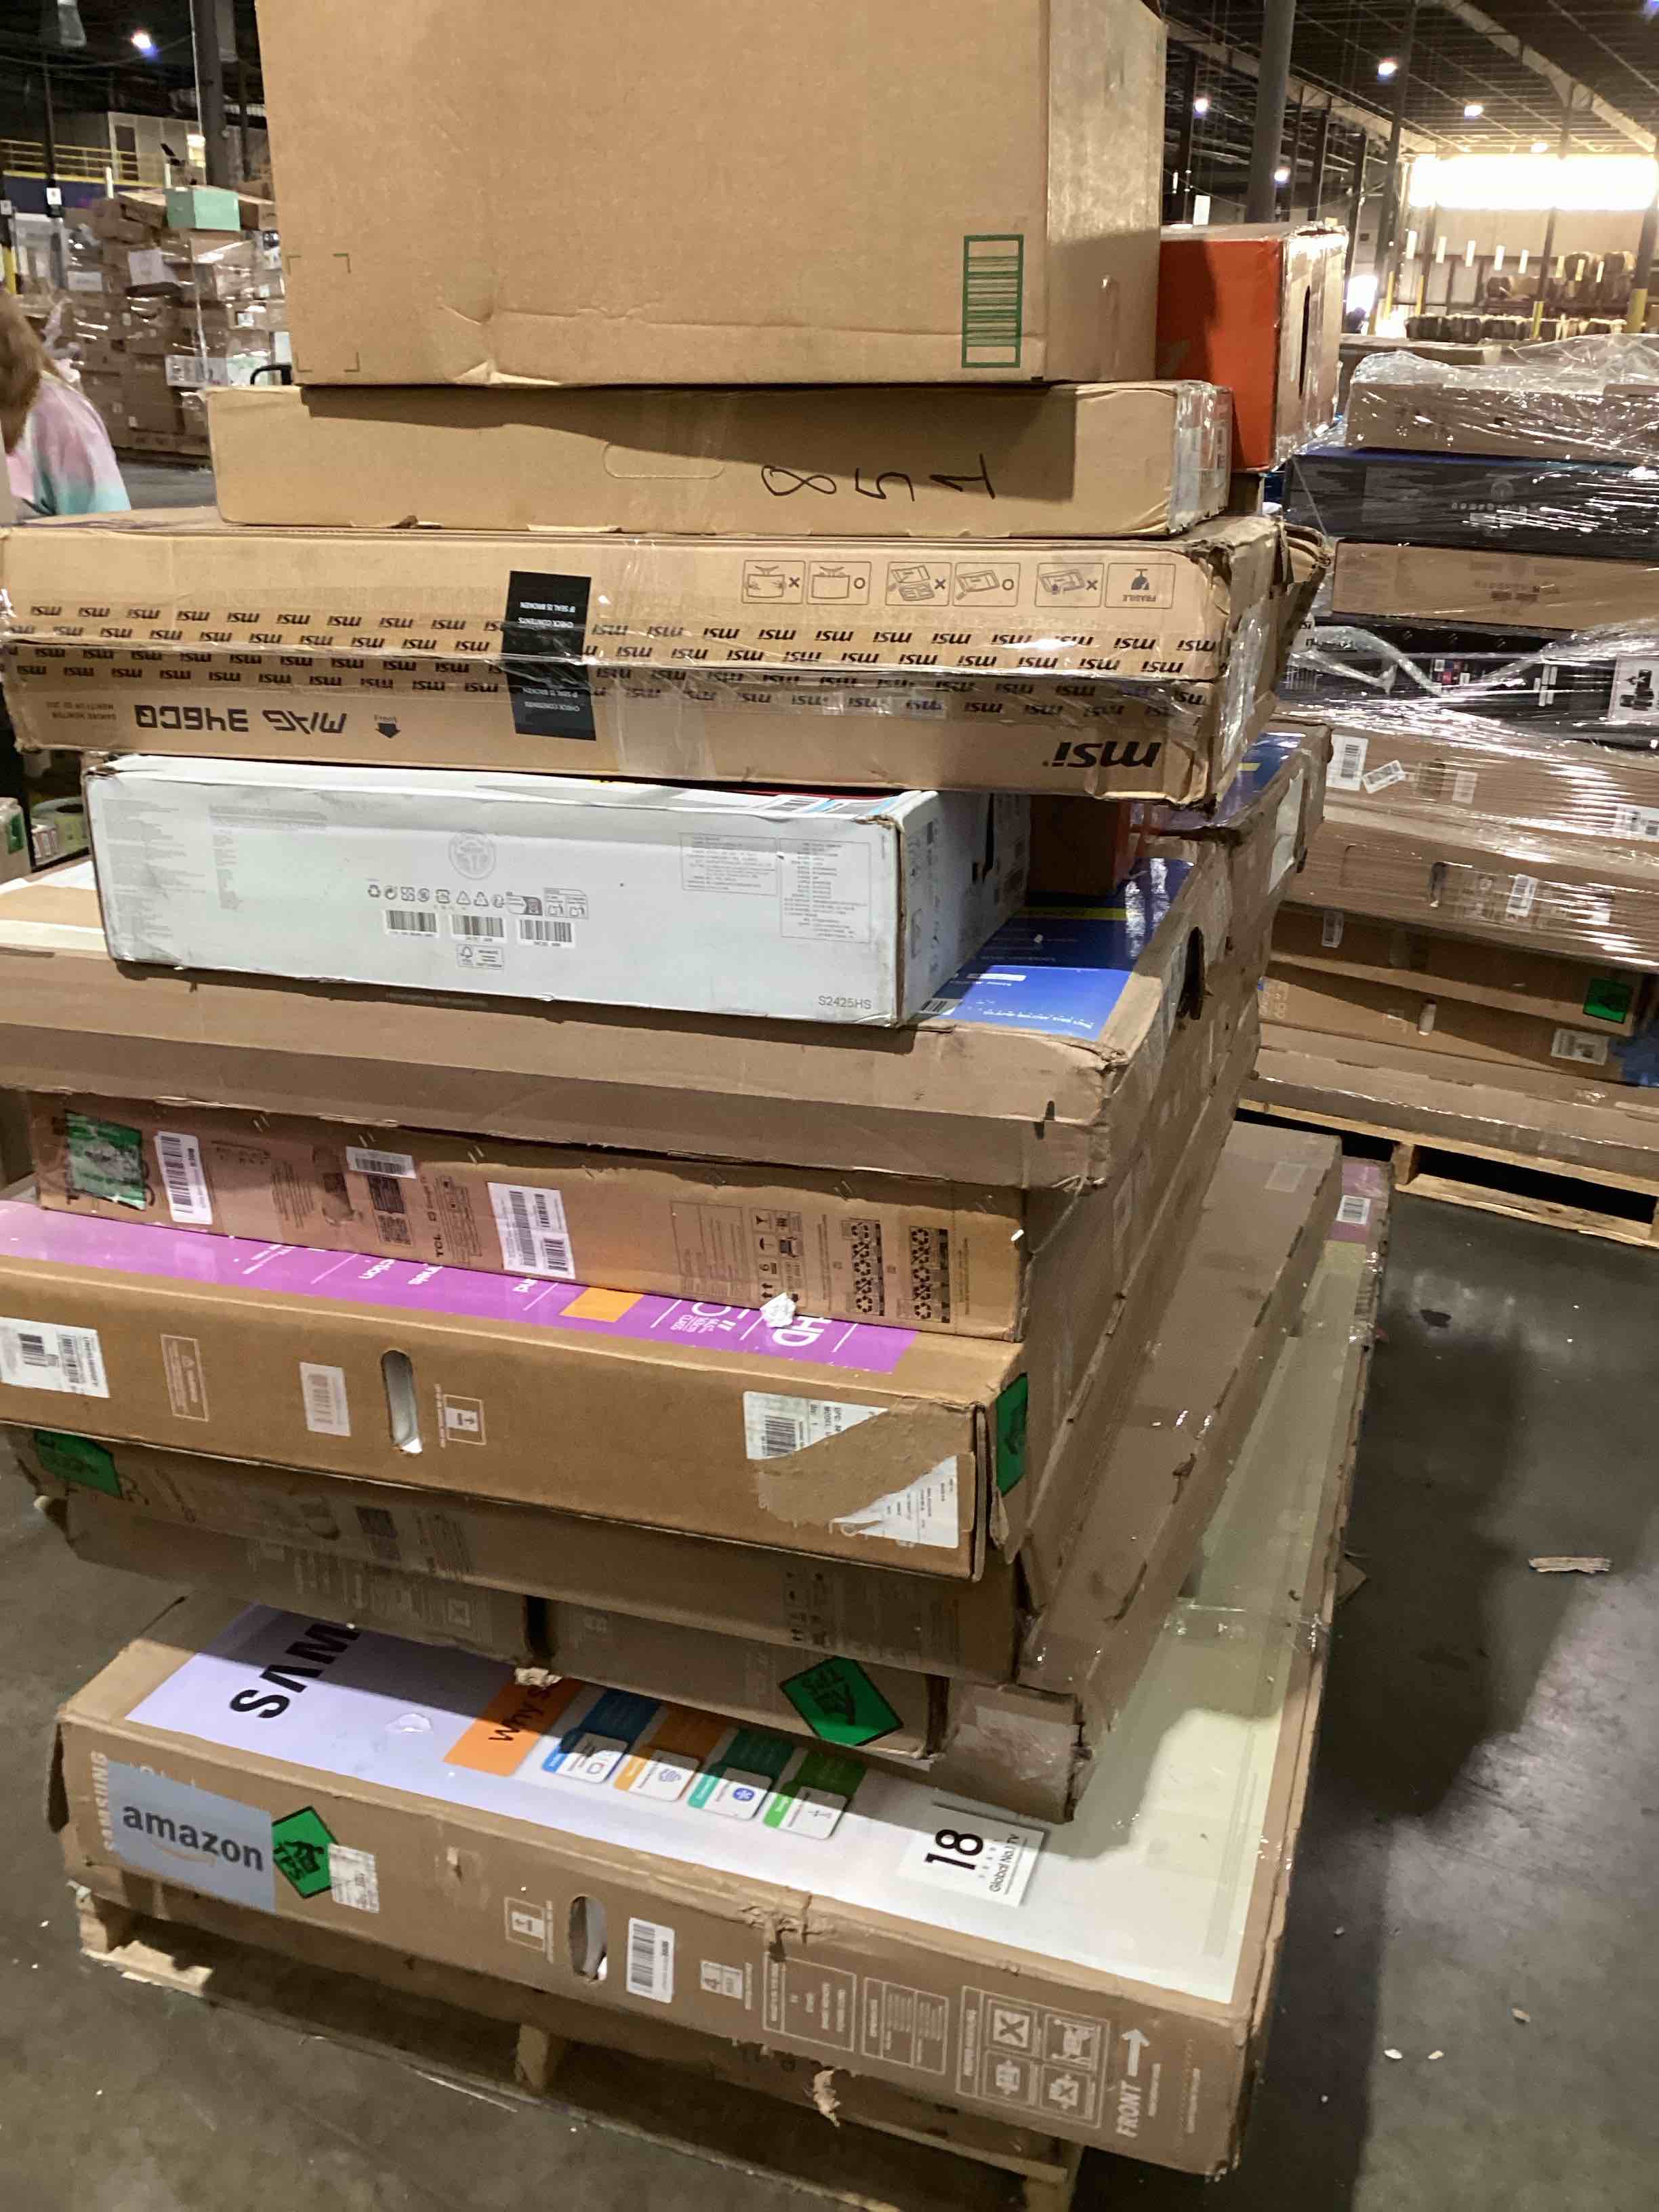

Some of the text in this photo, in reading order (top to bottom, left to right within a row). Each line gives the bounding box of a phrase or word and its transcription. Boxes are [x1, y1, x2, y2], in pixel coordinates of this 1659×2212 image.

[31, 606, 62, 615] msi
[79, 607, 110, 617] msi
[127, 609, 159, 618] msi
[178, 611, 209, 621] msi
[228, 612, 260, 623] msi
[277, 613, 310, 624] msi
[328, 615, 361, 626] msi
[380, 617, 413, 628] msi
[432, 619, 466, 631] msi
[484, 621, 505, 632] si
[592, 625, 629, 636] msi
[54, 626, 83, 636] msi
[100, 628, 132, 638] msi
[150, 630, 182, 640] msi
[647, 626, 683, 637] msi
[703, 628, 739, 638] msi
[759, 630, 796, 640] msi
[815, 630, 853, 642] msi
[199, 632, 232, 642] msi
[249, 633, 282, 644] msi
[301, 634, 333, 646] msi
[351, 637, 385, 648] msi
[873, 632, 912, 643] msi
[932, 632, 971, 644] msi
[992, 634, 1031, 646] msi
[403, 639, 437, 650] msi
[455, 640, 489, 651] msi
[1114, 637, 1155, 650] msi
[1177, 639, 1216, 653] msi
[35, 648, 65, 657] msi
[83, 649, 114, 659] msi
[131, 651, 163, 661] msi
[616, 646, 652, 657] msi
[671, 648, 708, 660] msi
[726, 649, 763, 661] msi
[785, 651, 821, 661] msi
[180, 652, 211, 663] msi
[230, 654, 263, 664] msi
[281, 656, 312, 667] msi
[842, 653, 879, 664] msi
[899, 654, 938, 665] msi
[958, 655, 996, 667] msi
[1018, 656, 1058, 668] msi
[331, 657, 365, 670] msi
[383, 660, 416, 671] msi
[435, 663, 469, 674] msi
[1079, 658, 1120, 670] msi
[1141, 660, 1183, 673] msi
[17, 665, 46, 675] msi
[64, 667, 94, 677] msi
[112, 668, 142, 679] msi
[159, 670, 191, 680] msi
[596, 667, 632, 679] msi
[651, 668, 686, 680] msi
[209, 671, 241, 682] msi
[259, 674, 291, 684] msi
[309, 675, 342, 686] msi
[361, 678, 394, 690] msi
[412, 680, 445, 691] msi
[464, 682, 499, 693] msi
[995, 681, 1033, 695] msi
[1055, 683, 1096, 697] msi
[792, 694, 828, 706] msi
[963, 701, 1003, 714] msi
[1024, 703, 1063, 716] msi
[134, 704, 347, 735] MAG 346CQ
[1052, 741, 1162, 769] msi
[818, 995, 872, 1010] S2425HS
[433, 1233, 444, 1258] TCL
[123, 1803, 264, 1872] amazon
[924, 1828, 983, 1870] 18
[1115, 2079, 1143, 2138] FRONT
